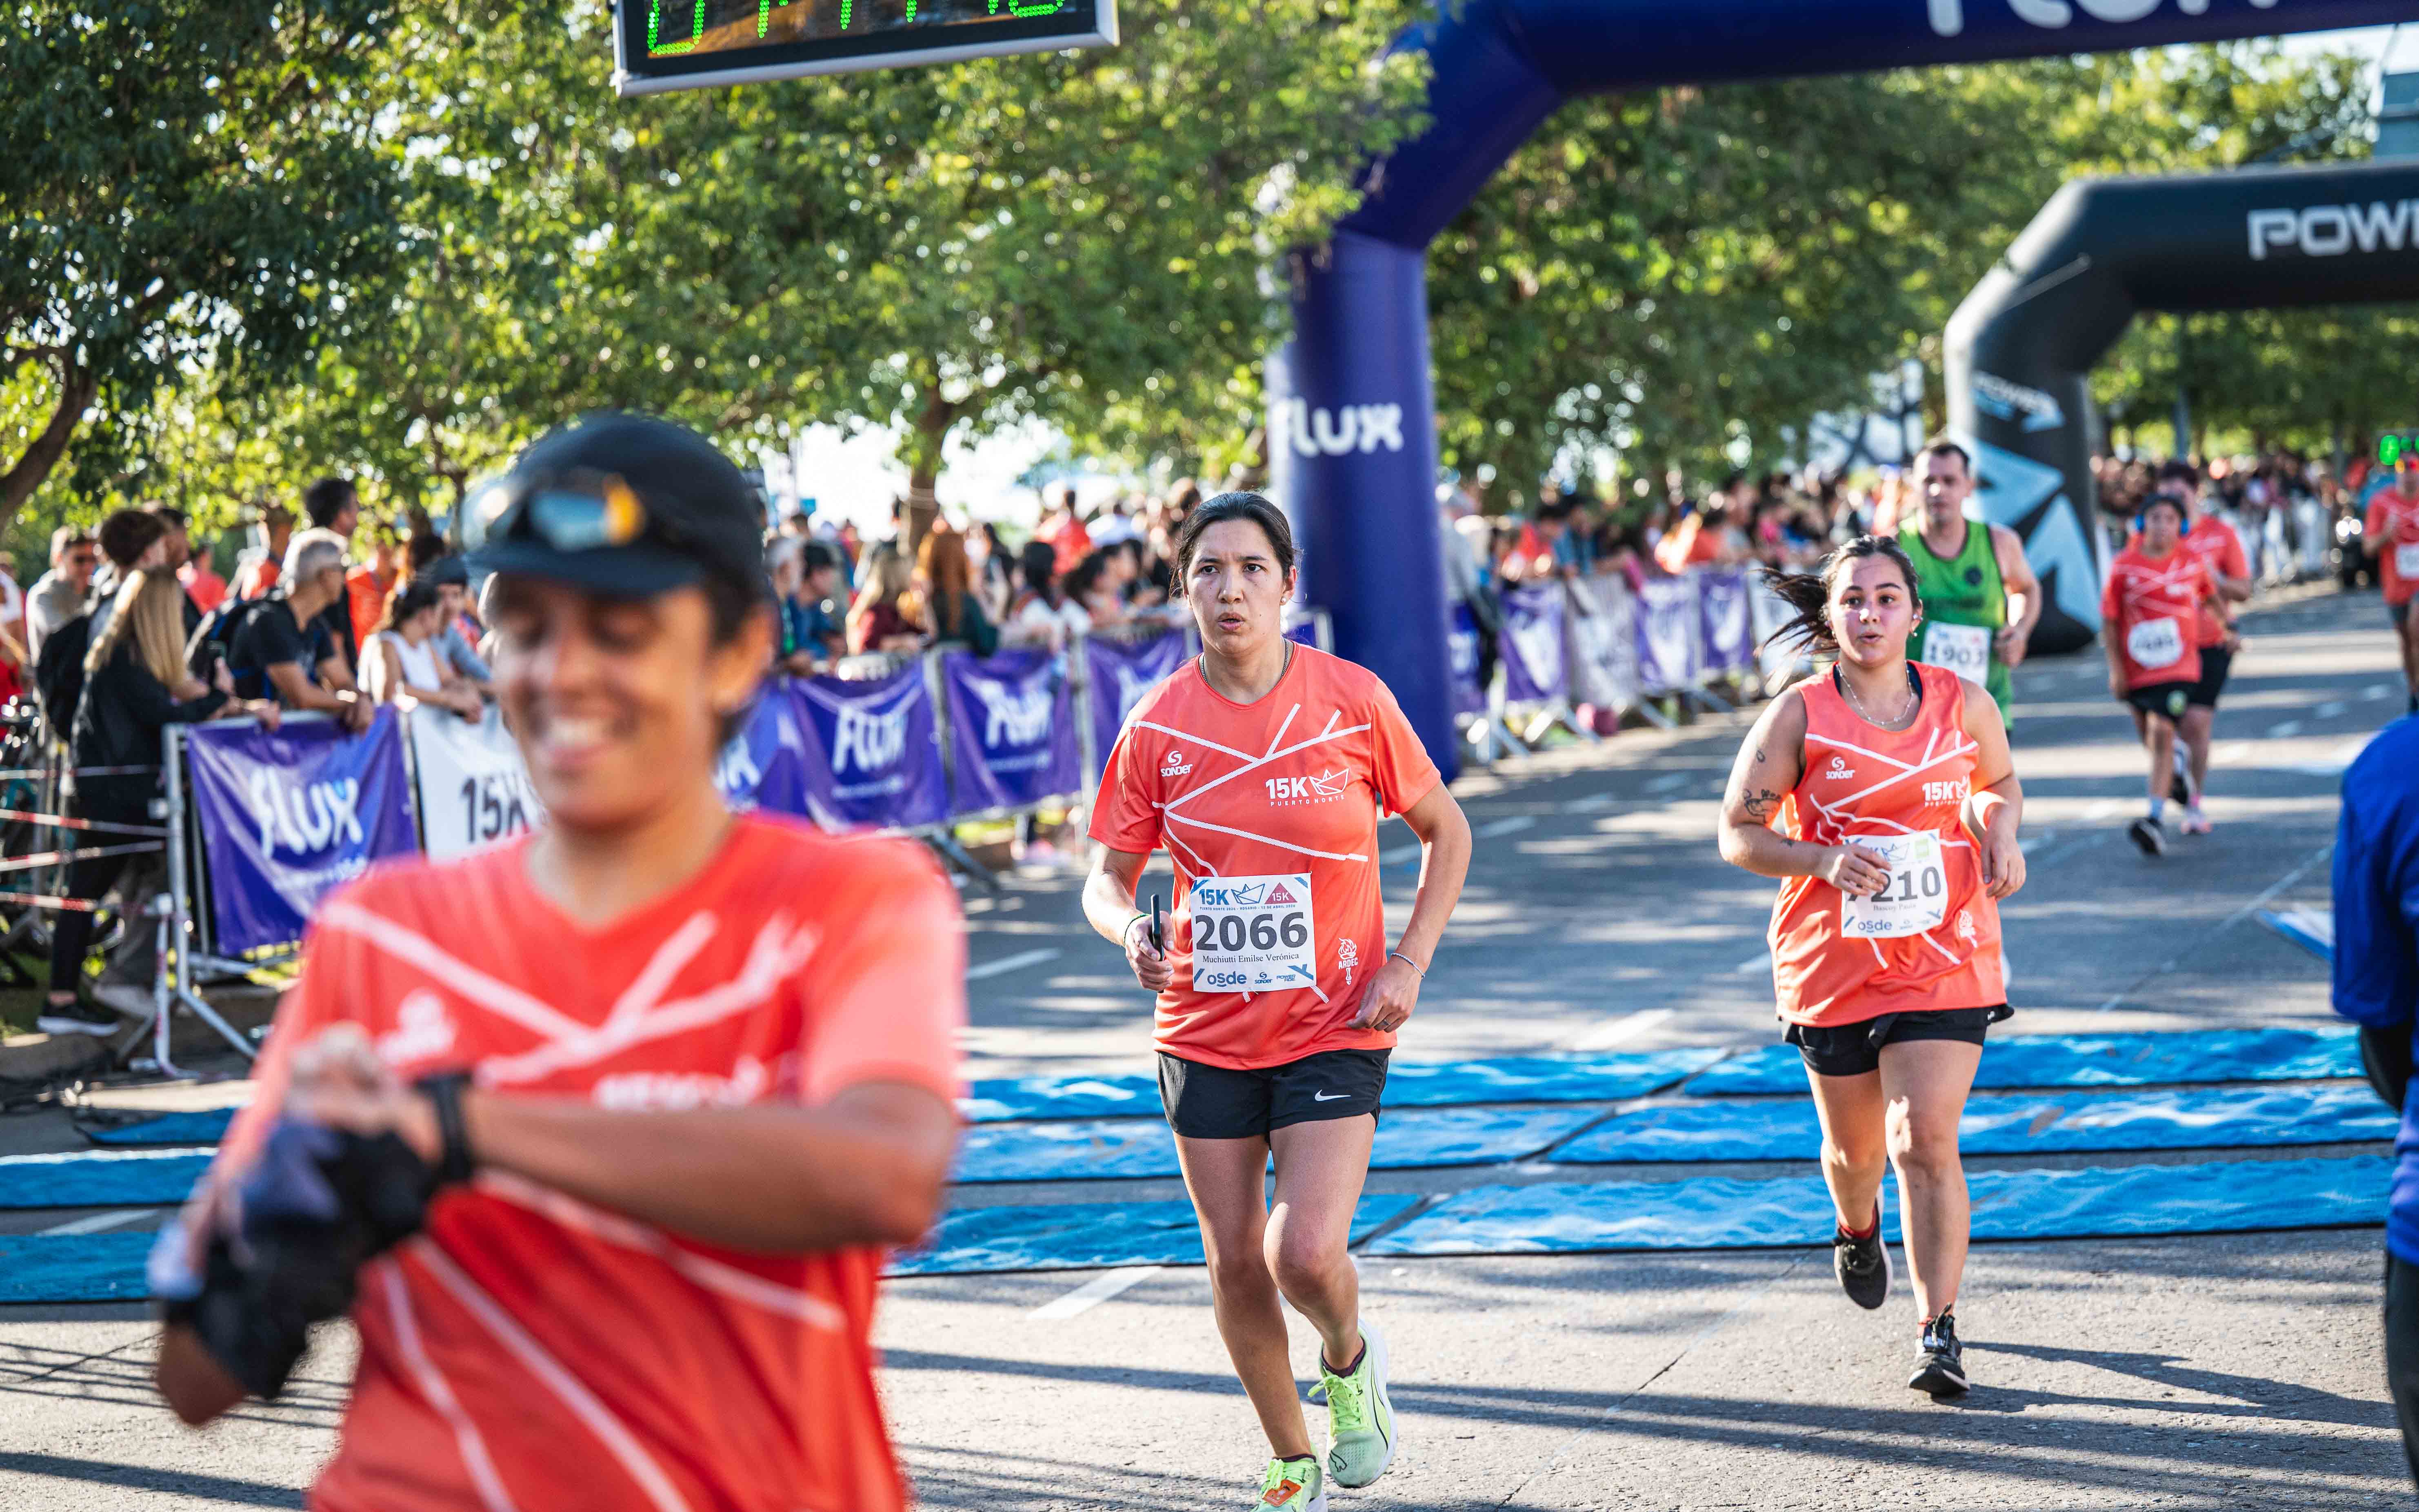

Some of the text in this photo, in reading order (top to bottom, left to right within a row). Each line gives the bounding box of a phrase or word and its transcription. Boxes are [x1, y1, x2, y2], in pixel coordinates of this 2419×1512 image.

[2246, 198, 2419, 261] POW
[1265, 777, 1309, 799] 15K
[1922, 781, 1953, 801] 15K
[1315, 795, 1345, 804] NORTE
[1848, 866, 1941, 902] 210
[1199, 888, 1230, 906] 15K
[1272, 892, 1290, 901] 15K
[1195, 912, 1308, 951] 2066
[1857, 919, 1892, 932] osde
[1203, 955, 1236, 963] Muchiutti
[1266, 953, 1299, 961] Verónica
[1338, 957, 1358, 970] ARDEC
[1207, 970, 1247, 986] osde
